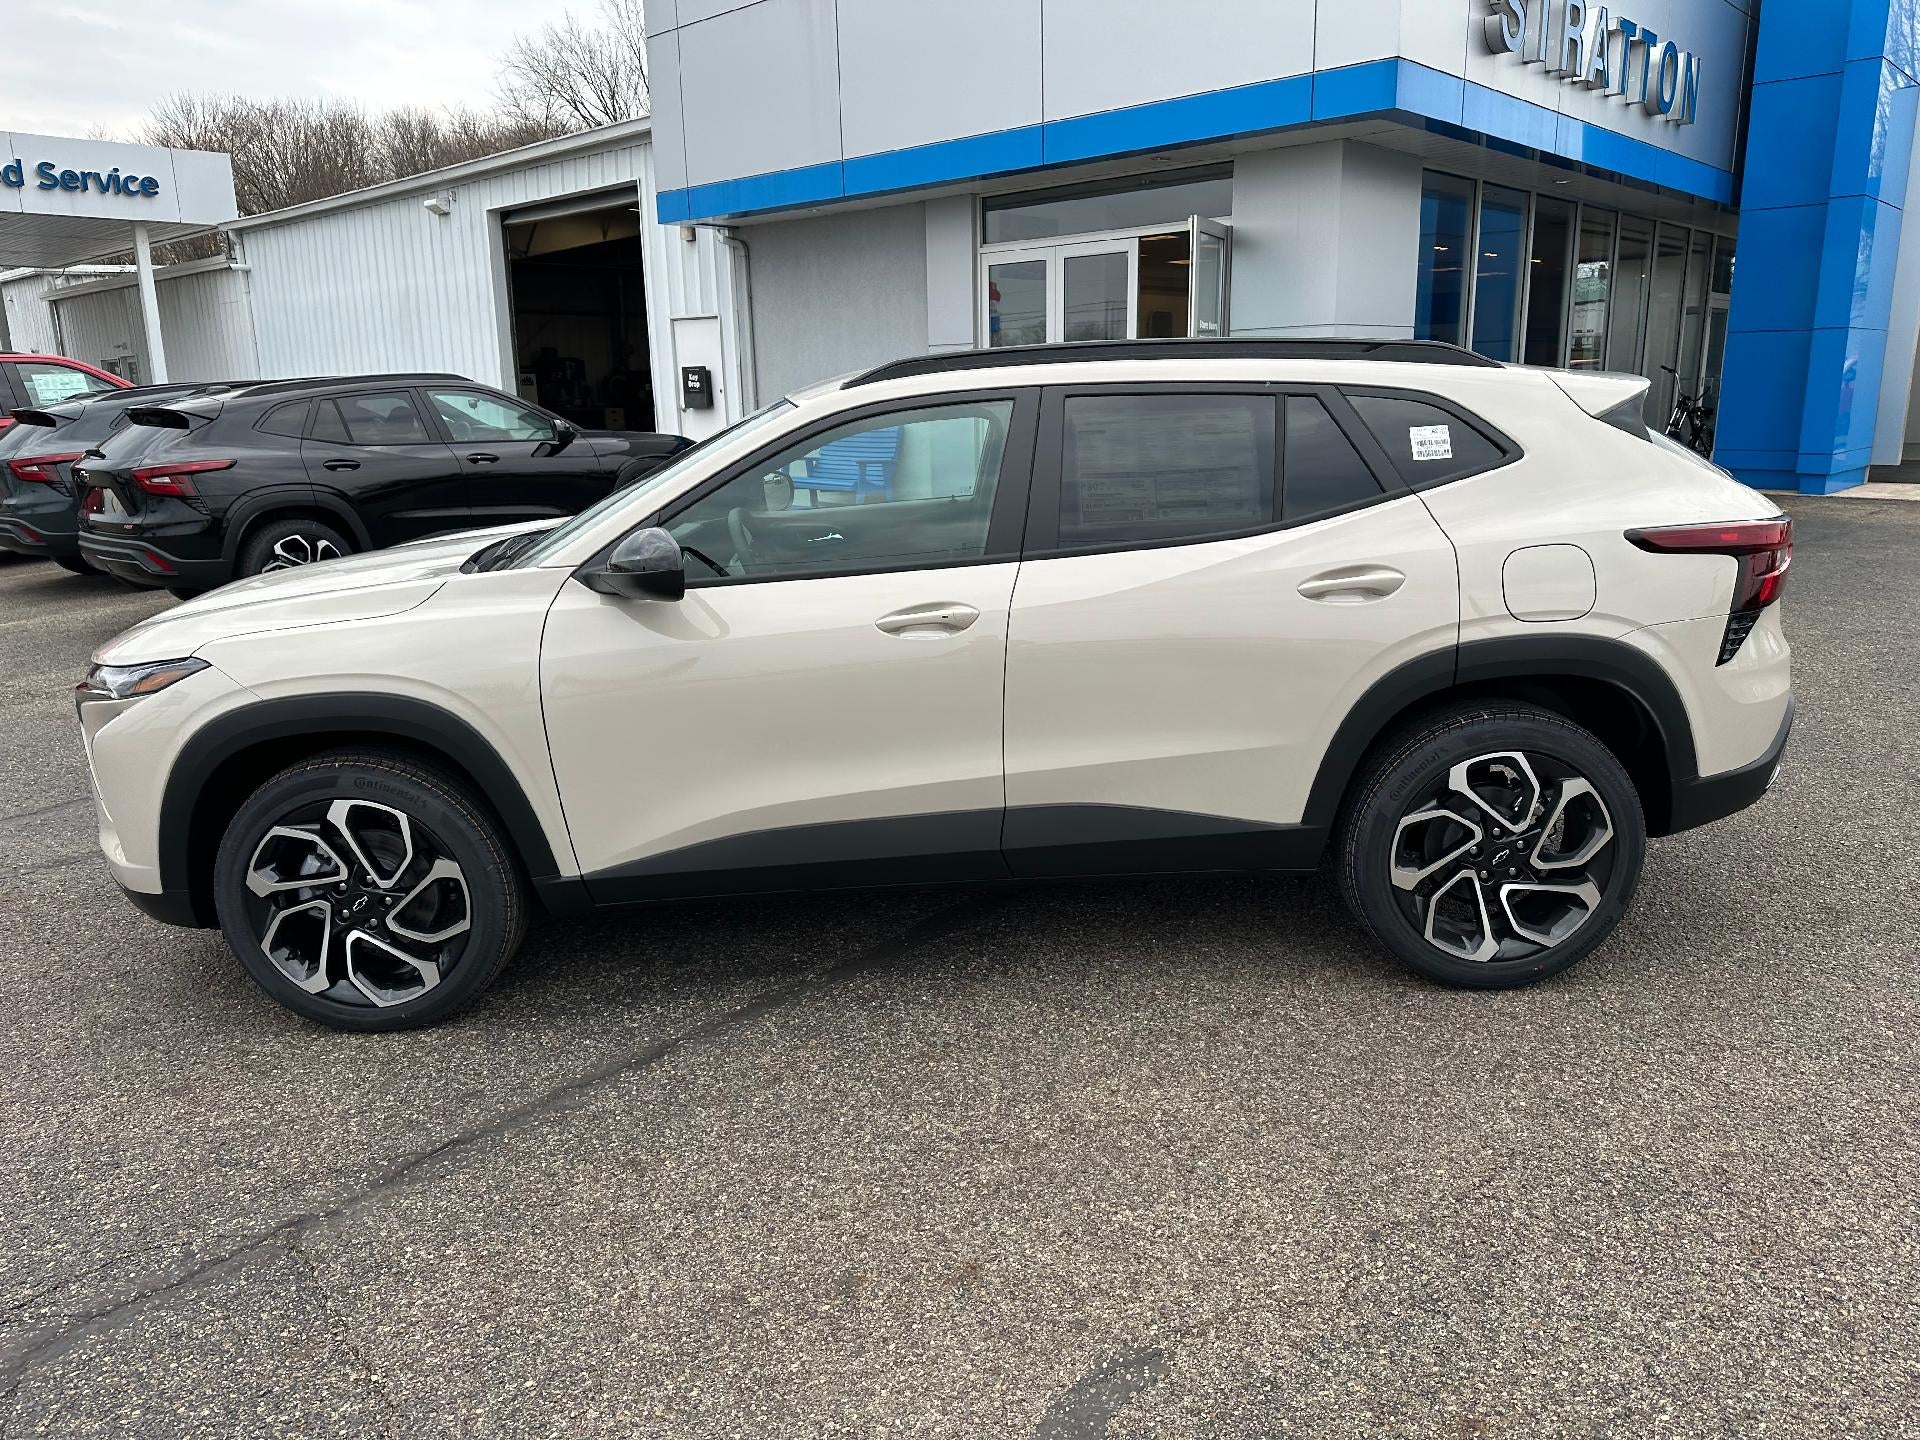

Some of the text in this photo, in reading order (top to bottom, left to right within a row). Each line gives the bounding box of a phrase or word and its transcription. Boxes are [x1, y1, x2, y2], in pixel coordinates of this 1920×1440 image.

[1484, 0, 1701, 125] STRATTON
[0, 158, 160, 197] d Service
[687, 380, 700, 389] Drop
[688, 373, 699, 382] Key
